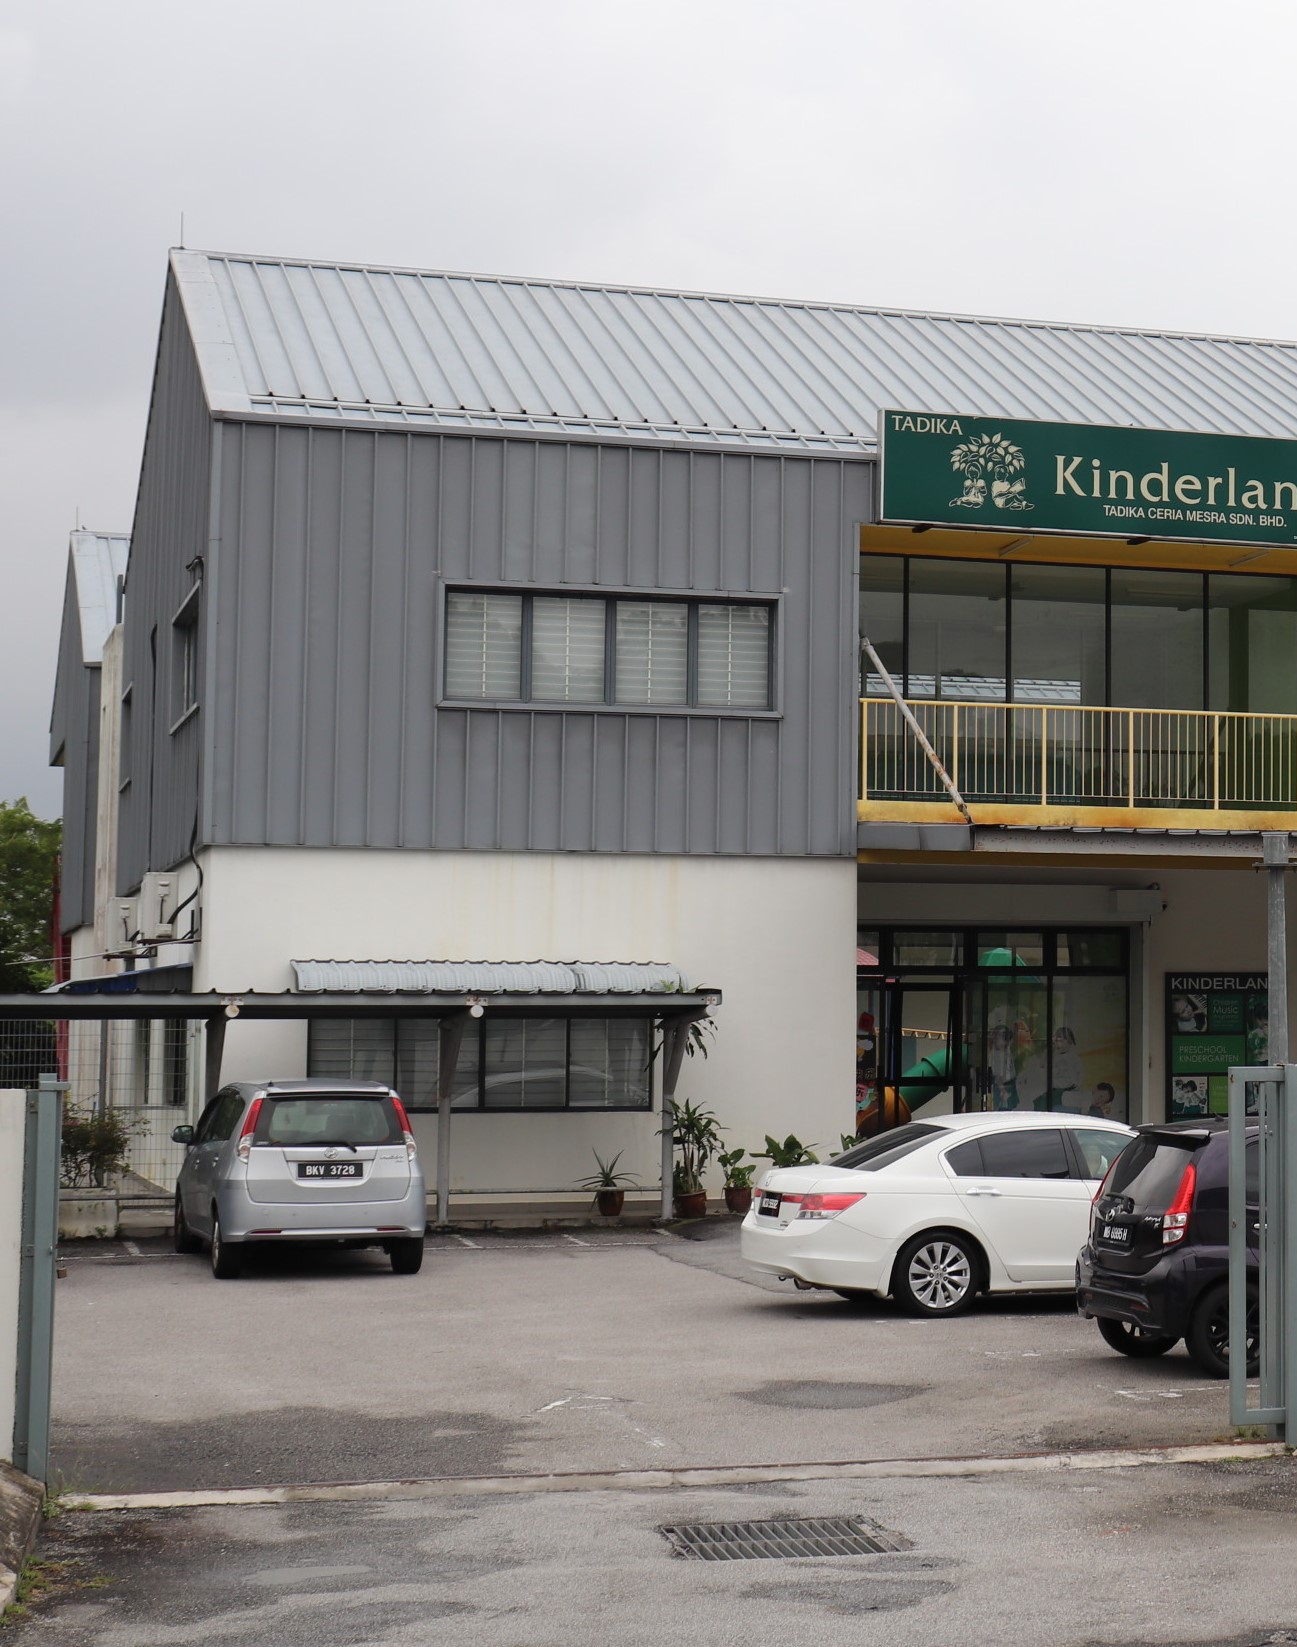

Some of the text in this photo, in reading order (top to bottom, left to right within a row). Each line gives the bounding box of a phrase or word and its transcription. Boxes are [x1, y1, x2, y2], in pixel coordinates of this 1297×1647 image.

[891, 415, 963, 436] TADIKA
[1103, 505, 1287, 527] TADIKA CERIA MESRA SDN. BHD.
[1172, 978, 1268, 990] KINDERLAN
[1213, 1006, 1238, 1014] Music
[1179, 1046, 1227, 1054] PRESCHOOL
[1179, 1054, 1238, 1062] KINDERGARTEN
[306, 1166, 355, 1175] BKV 3728
